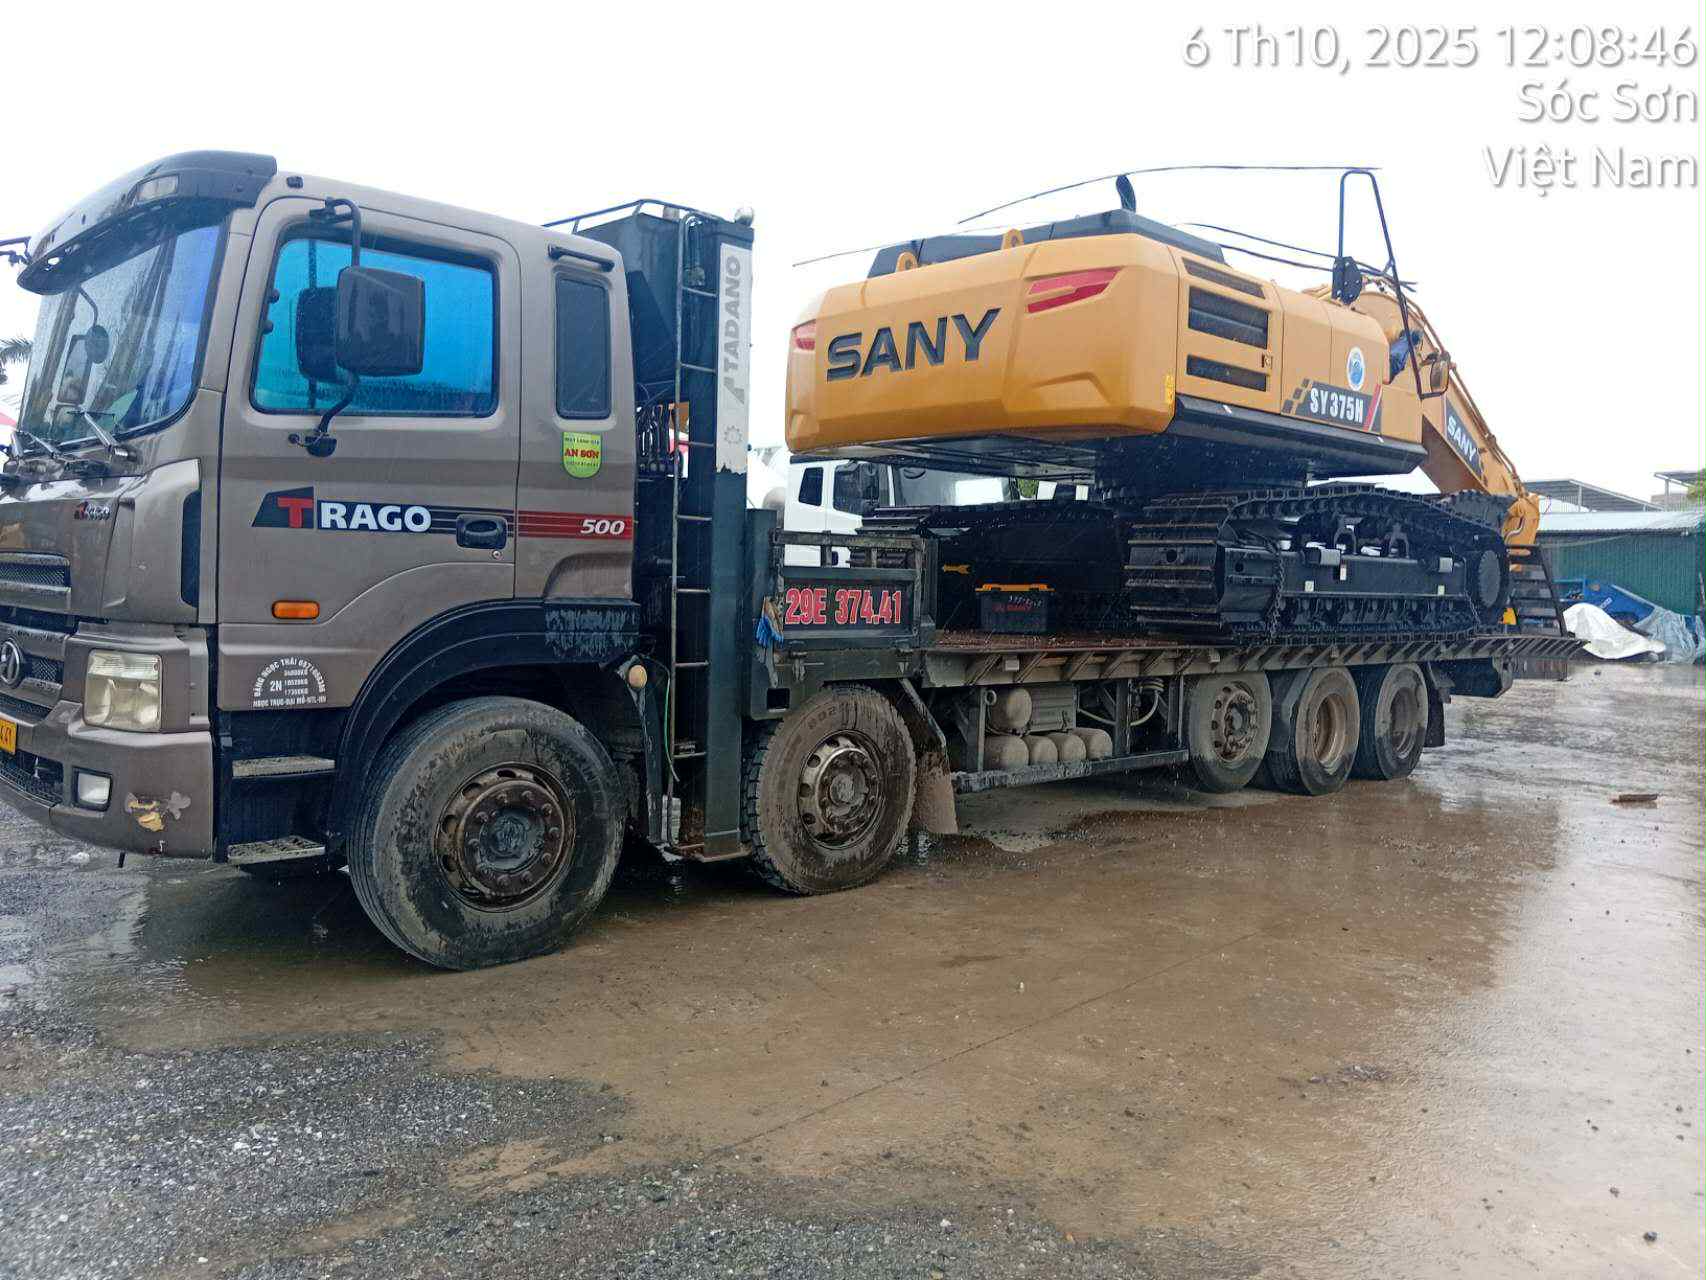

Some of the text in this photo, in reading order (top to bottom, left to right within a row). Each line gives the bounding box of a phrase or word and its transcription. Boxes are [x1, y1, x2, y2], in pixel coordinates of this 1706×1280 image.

[724, 255, 741, 373] TADANO
[827, 307, 1001, 384] SANY
[1447, 415, 1477, 462] SANY
[580, 518, 626, 535] 500
[784, 587, 902, 625] 29E 374.41
